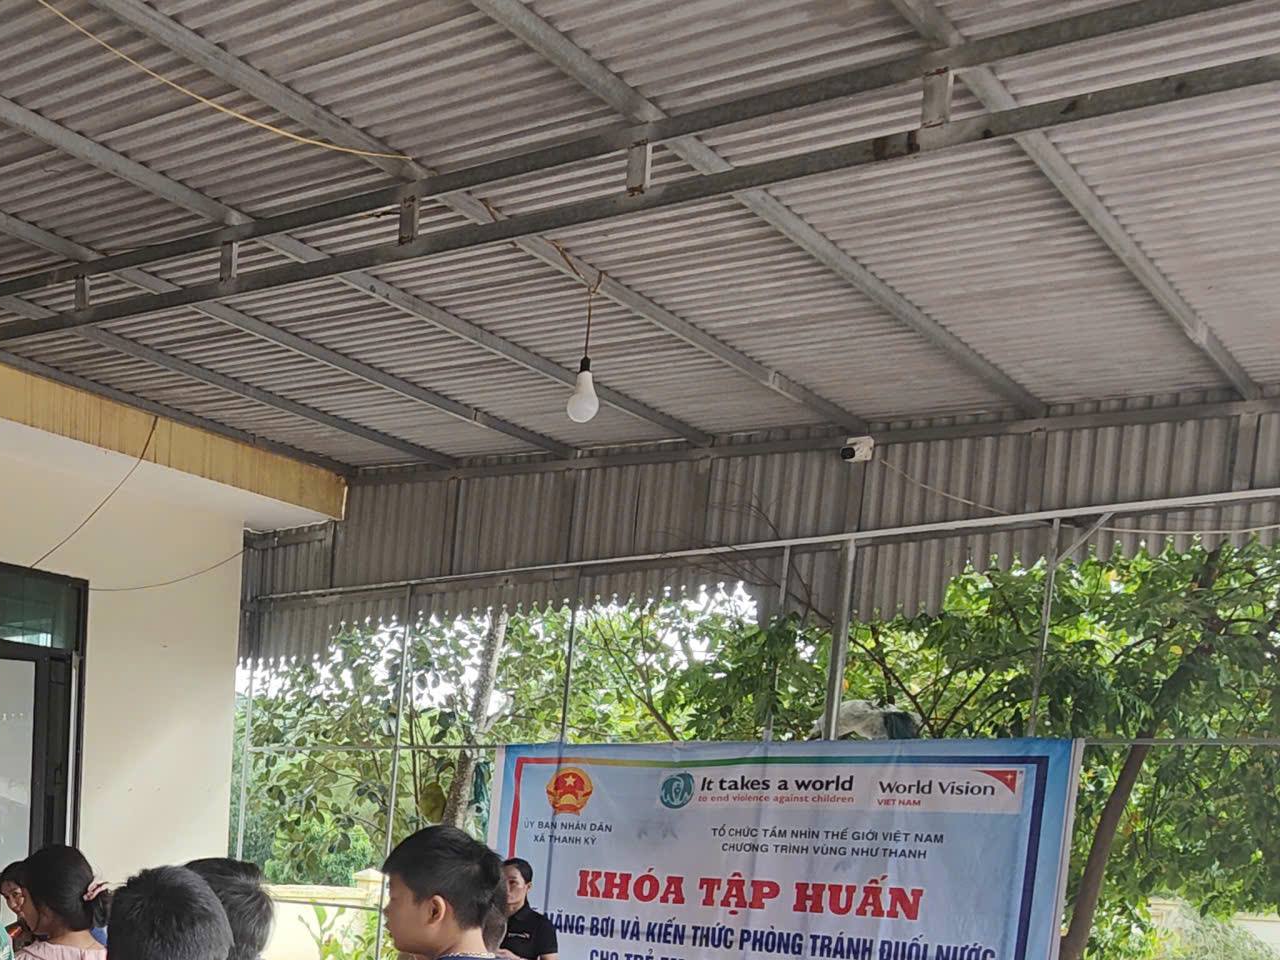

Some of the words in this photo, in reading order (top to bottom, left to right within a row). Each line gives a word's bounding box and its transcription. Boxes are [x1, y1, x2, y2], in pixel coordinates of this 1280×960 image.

[701, 776, 714, 791] It
[719, 775, 770, 791] takes
[777, 779, 789, 791] a
[795, 775, 854, 791] world
[879, 780, 932, 795] World
[938, 781, 995, 796] Vision
[698, 794, 708, 802] to
[711, 793, 729, 802] end
[732, 793, 769, 802] violence
[773, 794, 809, 804] against
[811, 794, 854, 803] children
[538, 821, 557, 830] BAN
[548, 834, 582, 845] THANH
[914, 833, 944, 844] NAM
[721, 842, 769, 853] CHƯƠNG
[851, 846, 880, 858] NHƯ
[881, 848, 927, 859] THANH
[577, 868, 685, 904] KHÓA
[699, 872, 781, 915] TẬP
[792, 875, 924, 921] HUẤN
[589, 916, 616, 939] BƠI
[620, 916, 642, 941] VÀ
[645, 916, 687, 946] KIẾN
[691, 922, 735, 950] THỨC
[738, 925, 804, 956] PHÒNG
